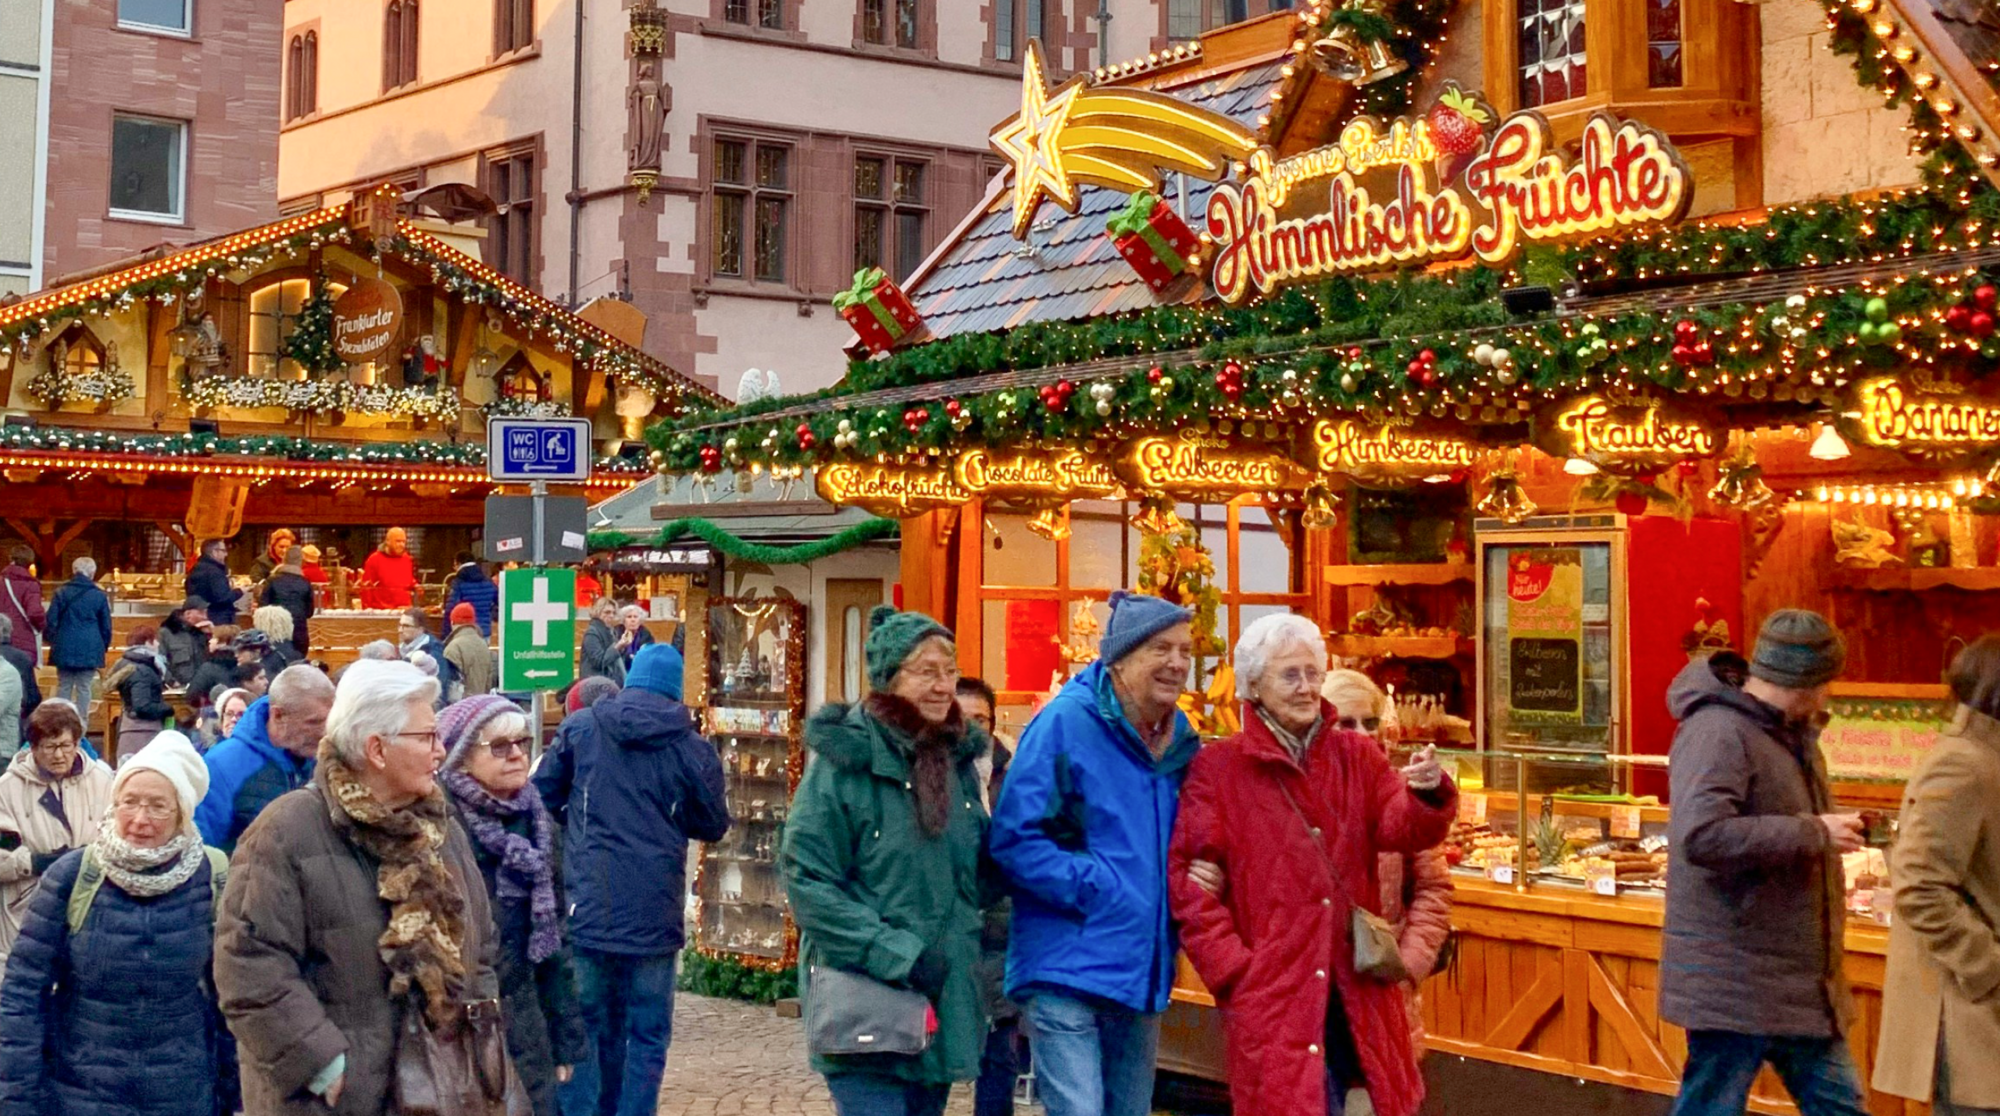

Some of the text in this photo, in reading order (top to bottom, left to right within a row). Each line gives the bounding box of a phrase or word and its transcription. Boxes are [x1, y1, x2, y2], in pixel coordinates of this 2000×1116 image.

[1207, 114, 1680, 300] Himmlische Früchte
[333, 307, 394, 342] Frankfurter
[1557, 397, 1713, 457] Trauben
[1861, 378, 2000, 445] Banane
[512, 433, 534, 446] WC
[1136, 437, 1280, 487] Erdbeeren
[1313, 419, 1474, 471] Himbeeren
[1512, 579, 1542, 597] heute!
[512, 649, 567, 660] Unfallhilfsstelle
